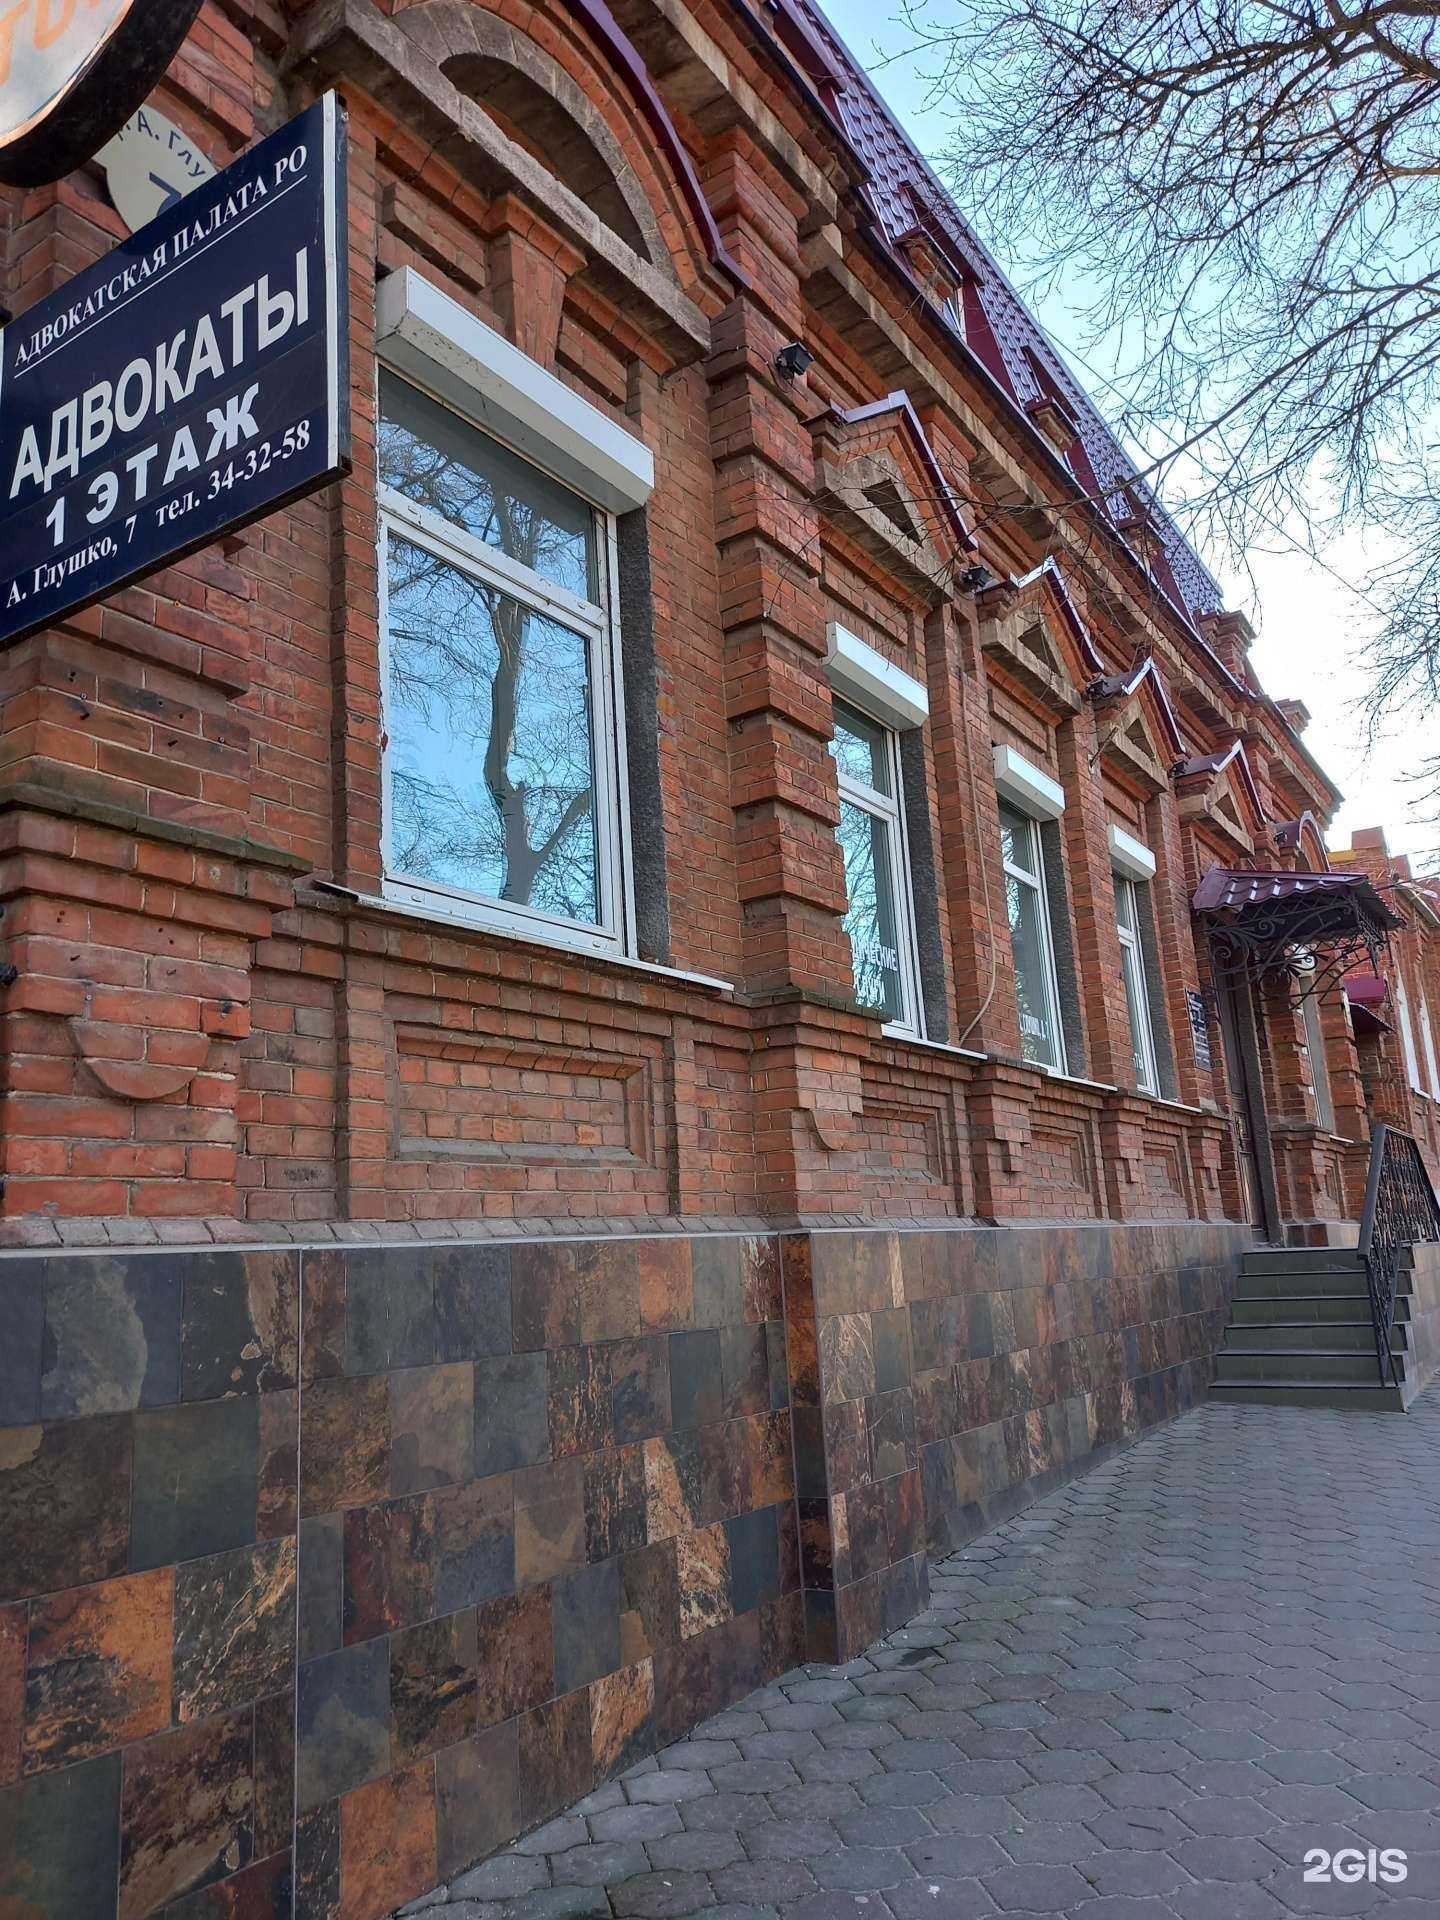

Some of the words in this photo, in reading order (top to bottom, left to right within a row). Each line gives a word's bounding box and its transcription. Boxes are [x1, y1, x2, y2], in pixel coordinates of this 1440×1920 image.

[14, 241, 167, 367] АДВОКАТСКАЯ
[172, 175, 268, 258] ПАЛАТА
[273, 144, 308, 186] РО
[9, 246, 309, 499] АДВОКАТЫ
[45, 496, 66, 547] 1
[86, 382, 261, 525] ЭТАЖ
[6, 580, 27, 609] А.
[33, 540, 119, 594] Глушко,
[124, 514, 138, 545] 7
[155, 490, 201, 528] тел.
[207, 419, 311, 500] 34-32-58
